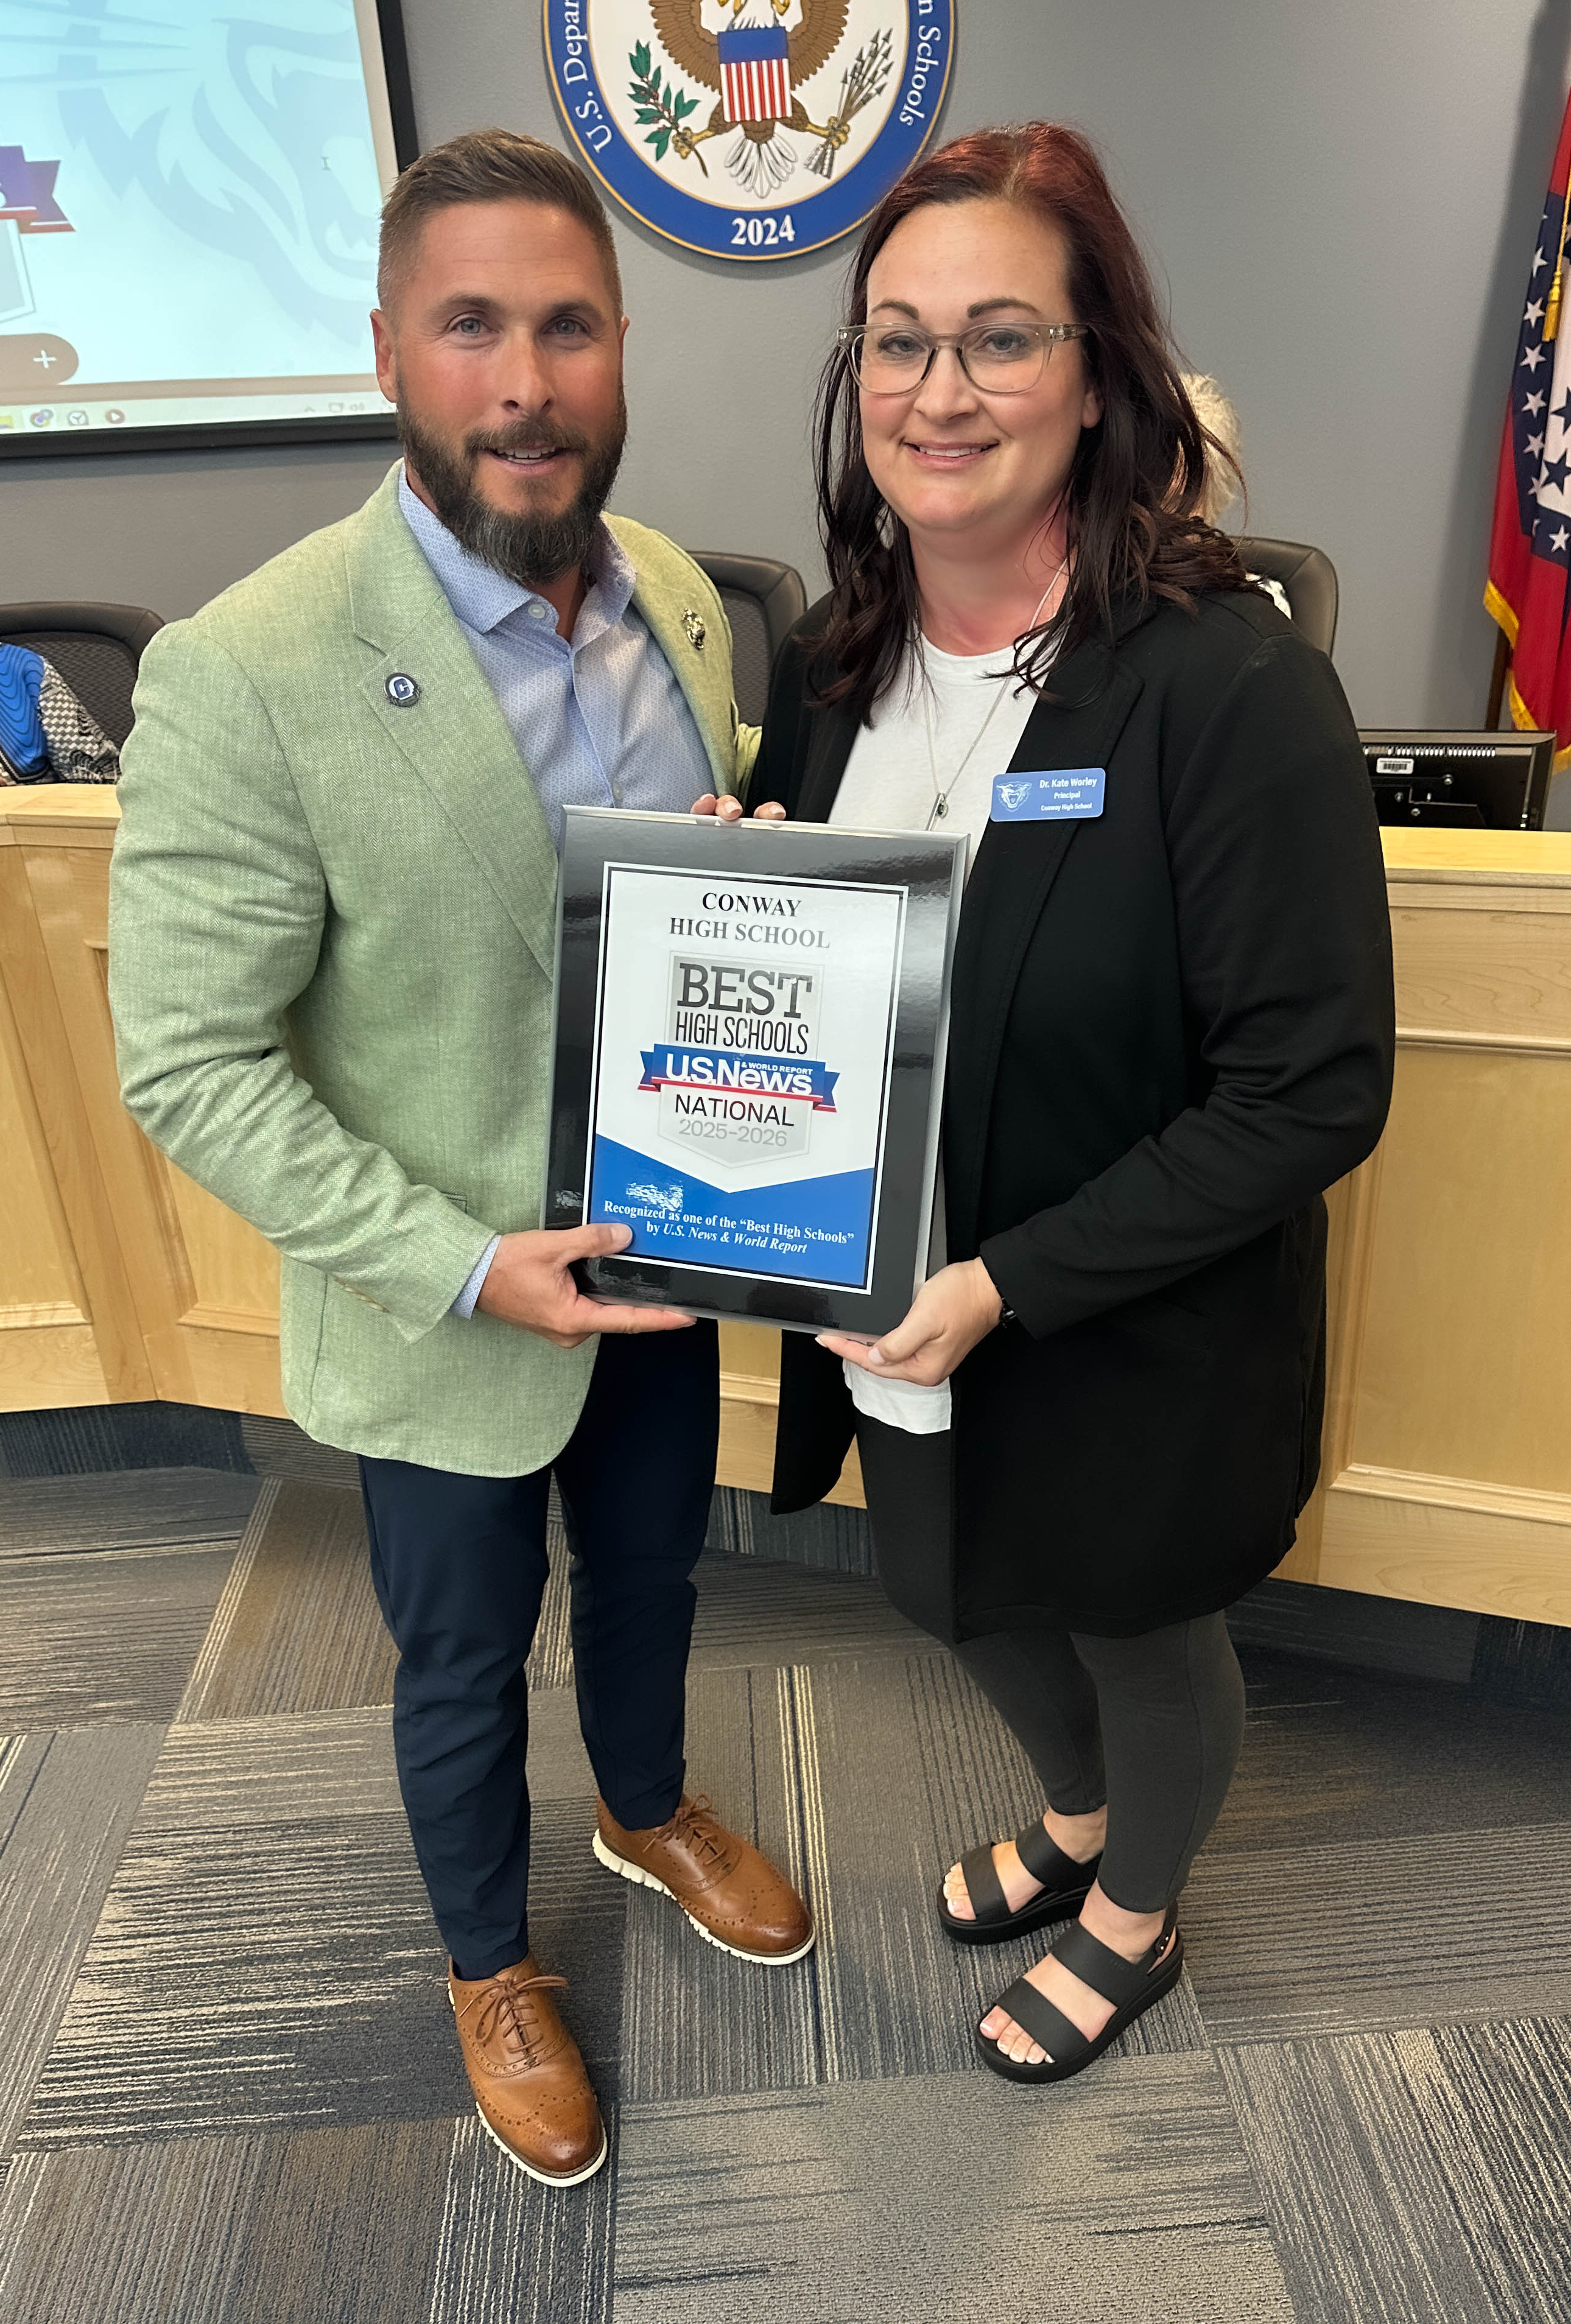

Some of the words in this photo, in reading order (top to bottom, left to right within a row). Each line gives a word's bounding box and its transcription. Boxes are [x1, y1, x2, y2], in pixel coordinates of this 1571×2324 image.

[899, 25, 941, 126] Schools
[575, 91, 612, 153] U.S.
[731, 214, 795, 245] 2024
[1039, 779, 1050, 788] Dr.
[1052, 779, 1069, 788] Kate
[1070, 777, 1097, 787] Worley
[1053, 790, 1081, 799] Principal
[702, 892, 802, 917] CONWAY
[669, 917, 728, 939] HIGH
[735, 923, 830, 949] SCHOOL
[677, 963, 813, 1019] BEST
[675, 1011, 719, 1045] HIGH
[723, 1016, 809, 1055] SCHOOLS
[748, 1062, 778, 1072] WORLD
[779, 1065, 814, 1075] REPORT
[675, 1094, 795, 1126] NATIONAL
[679, 1118, 787, 1146] 2025-2026
[604, 1200, 666, 1220] Recognized
[669, 1212, 680, 1222] as
[683, 1213, 703, 1224] one
[705, 1215, 719, 1226] of
[719, 1216, 737, 1229] the
[740, 1218, 771, 1234] “Best
[773, 1223, 801, 1240] High
[804, 1227, 854, 1244] Schools”
[646, 1221, 661, 1236] by
[663, 1223, 685, 1237] U.S.
[688, 1226, 717, 1241] News
[720, 1231, 730, 1243] &
[734, 1233, 768, 1248] World
[769, 1237, 807, 1254] Report
